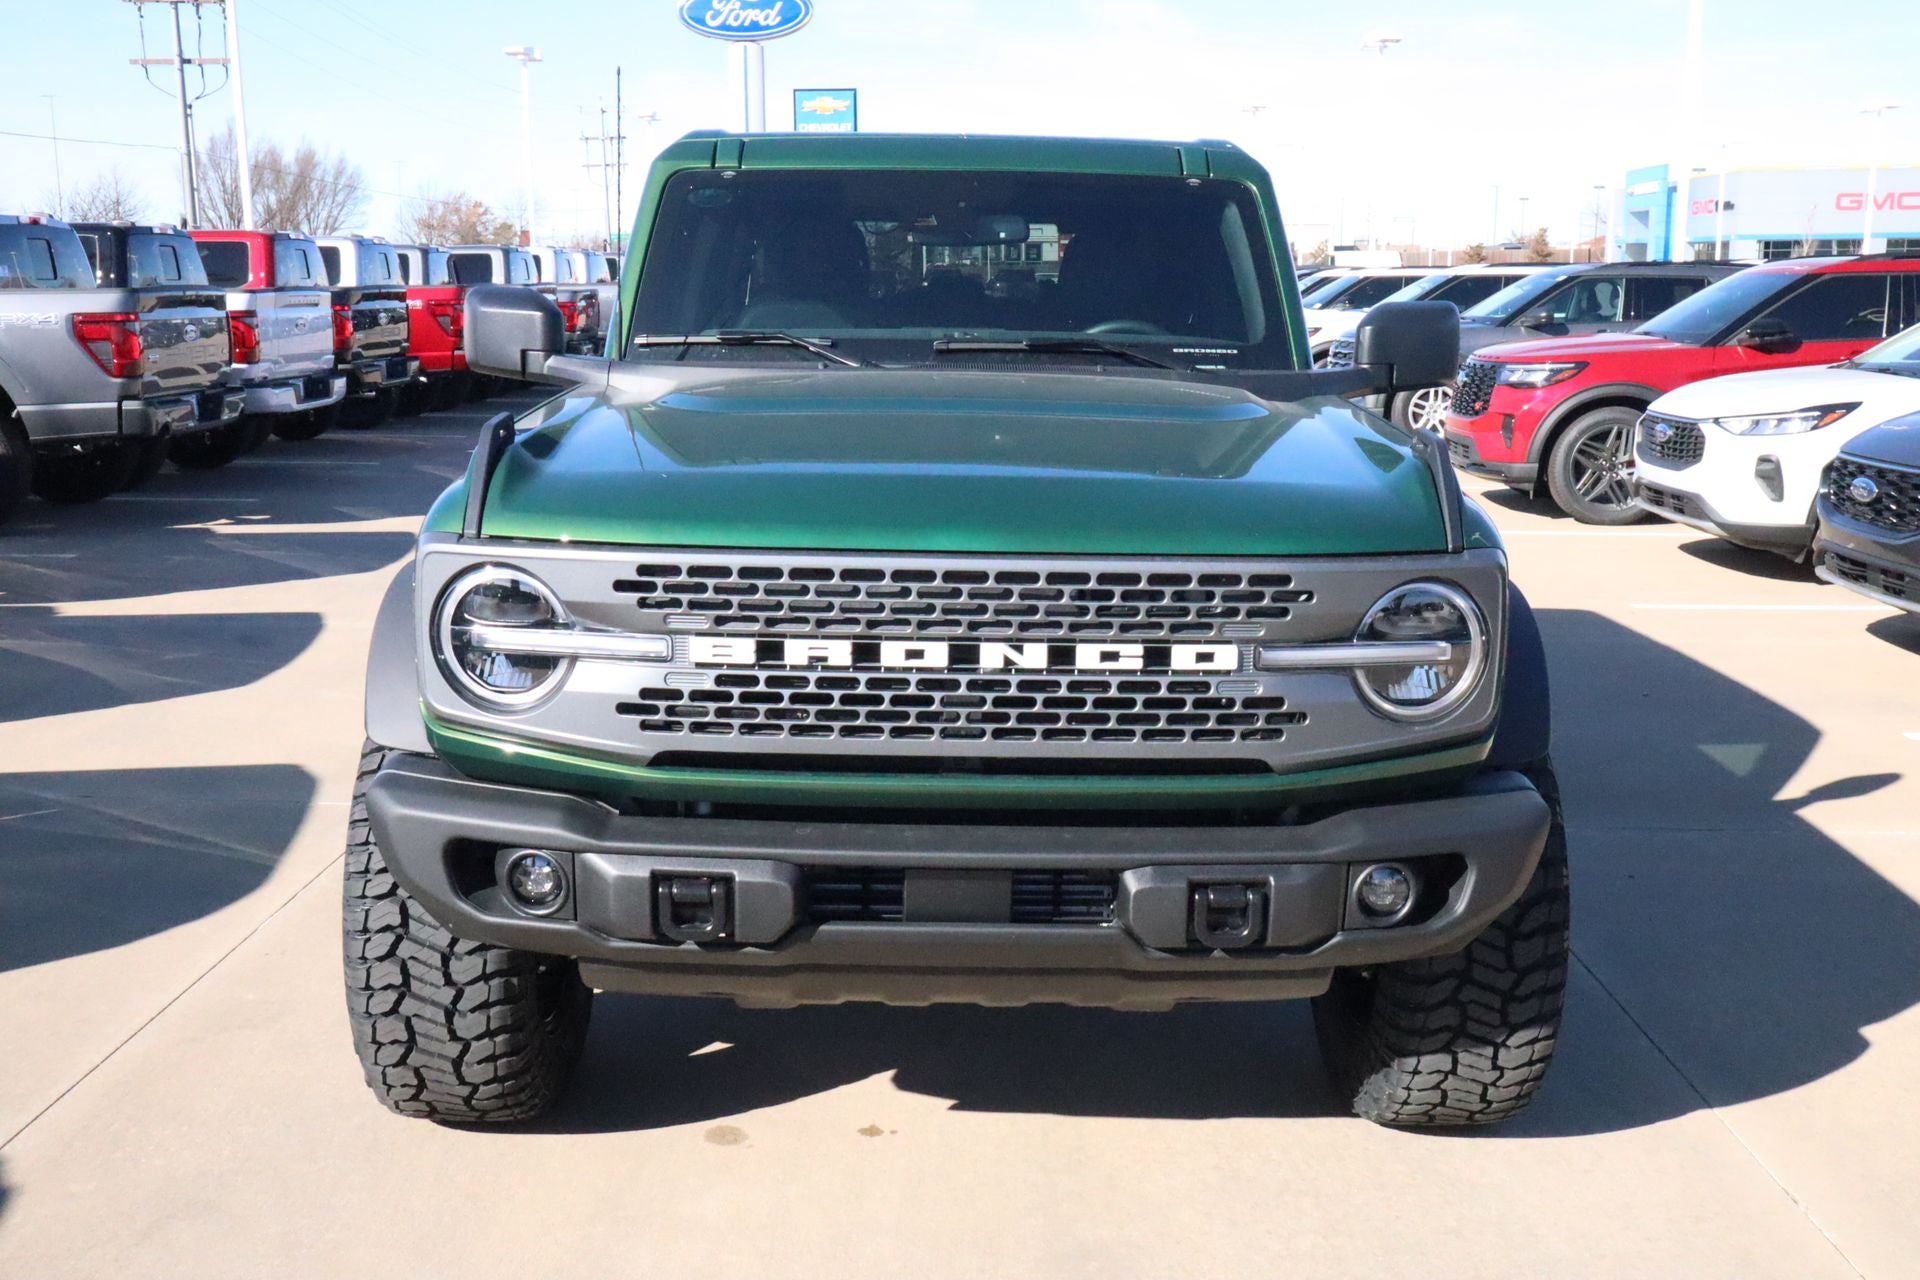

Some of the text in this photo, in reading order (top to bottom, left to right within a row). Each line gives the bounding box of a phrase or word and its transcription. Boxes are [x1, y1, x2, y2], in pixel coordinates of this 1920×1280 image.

[705, 0, 783, 27] Ford
[1835, 192, 1920, 211] GMC
[689, 636, 1239, 669] BRONCO
